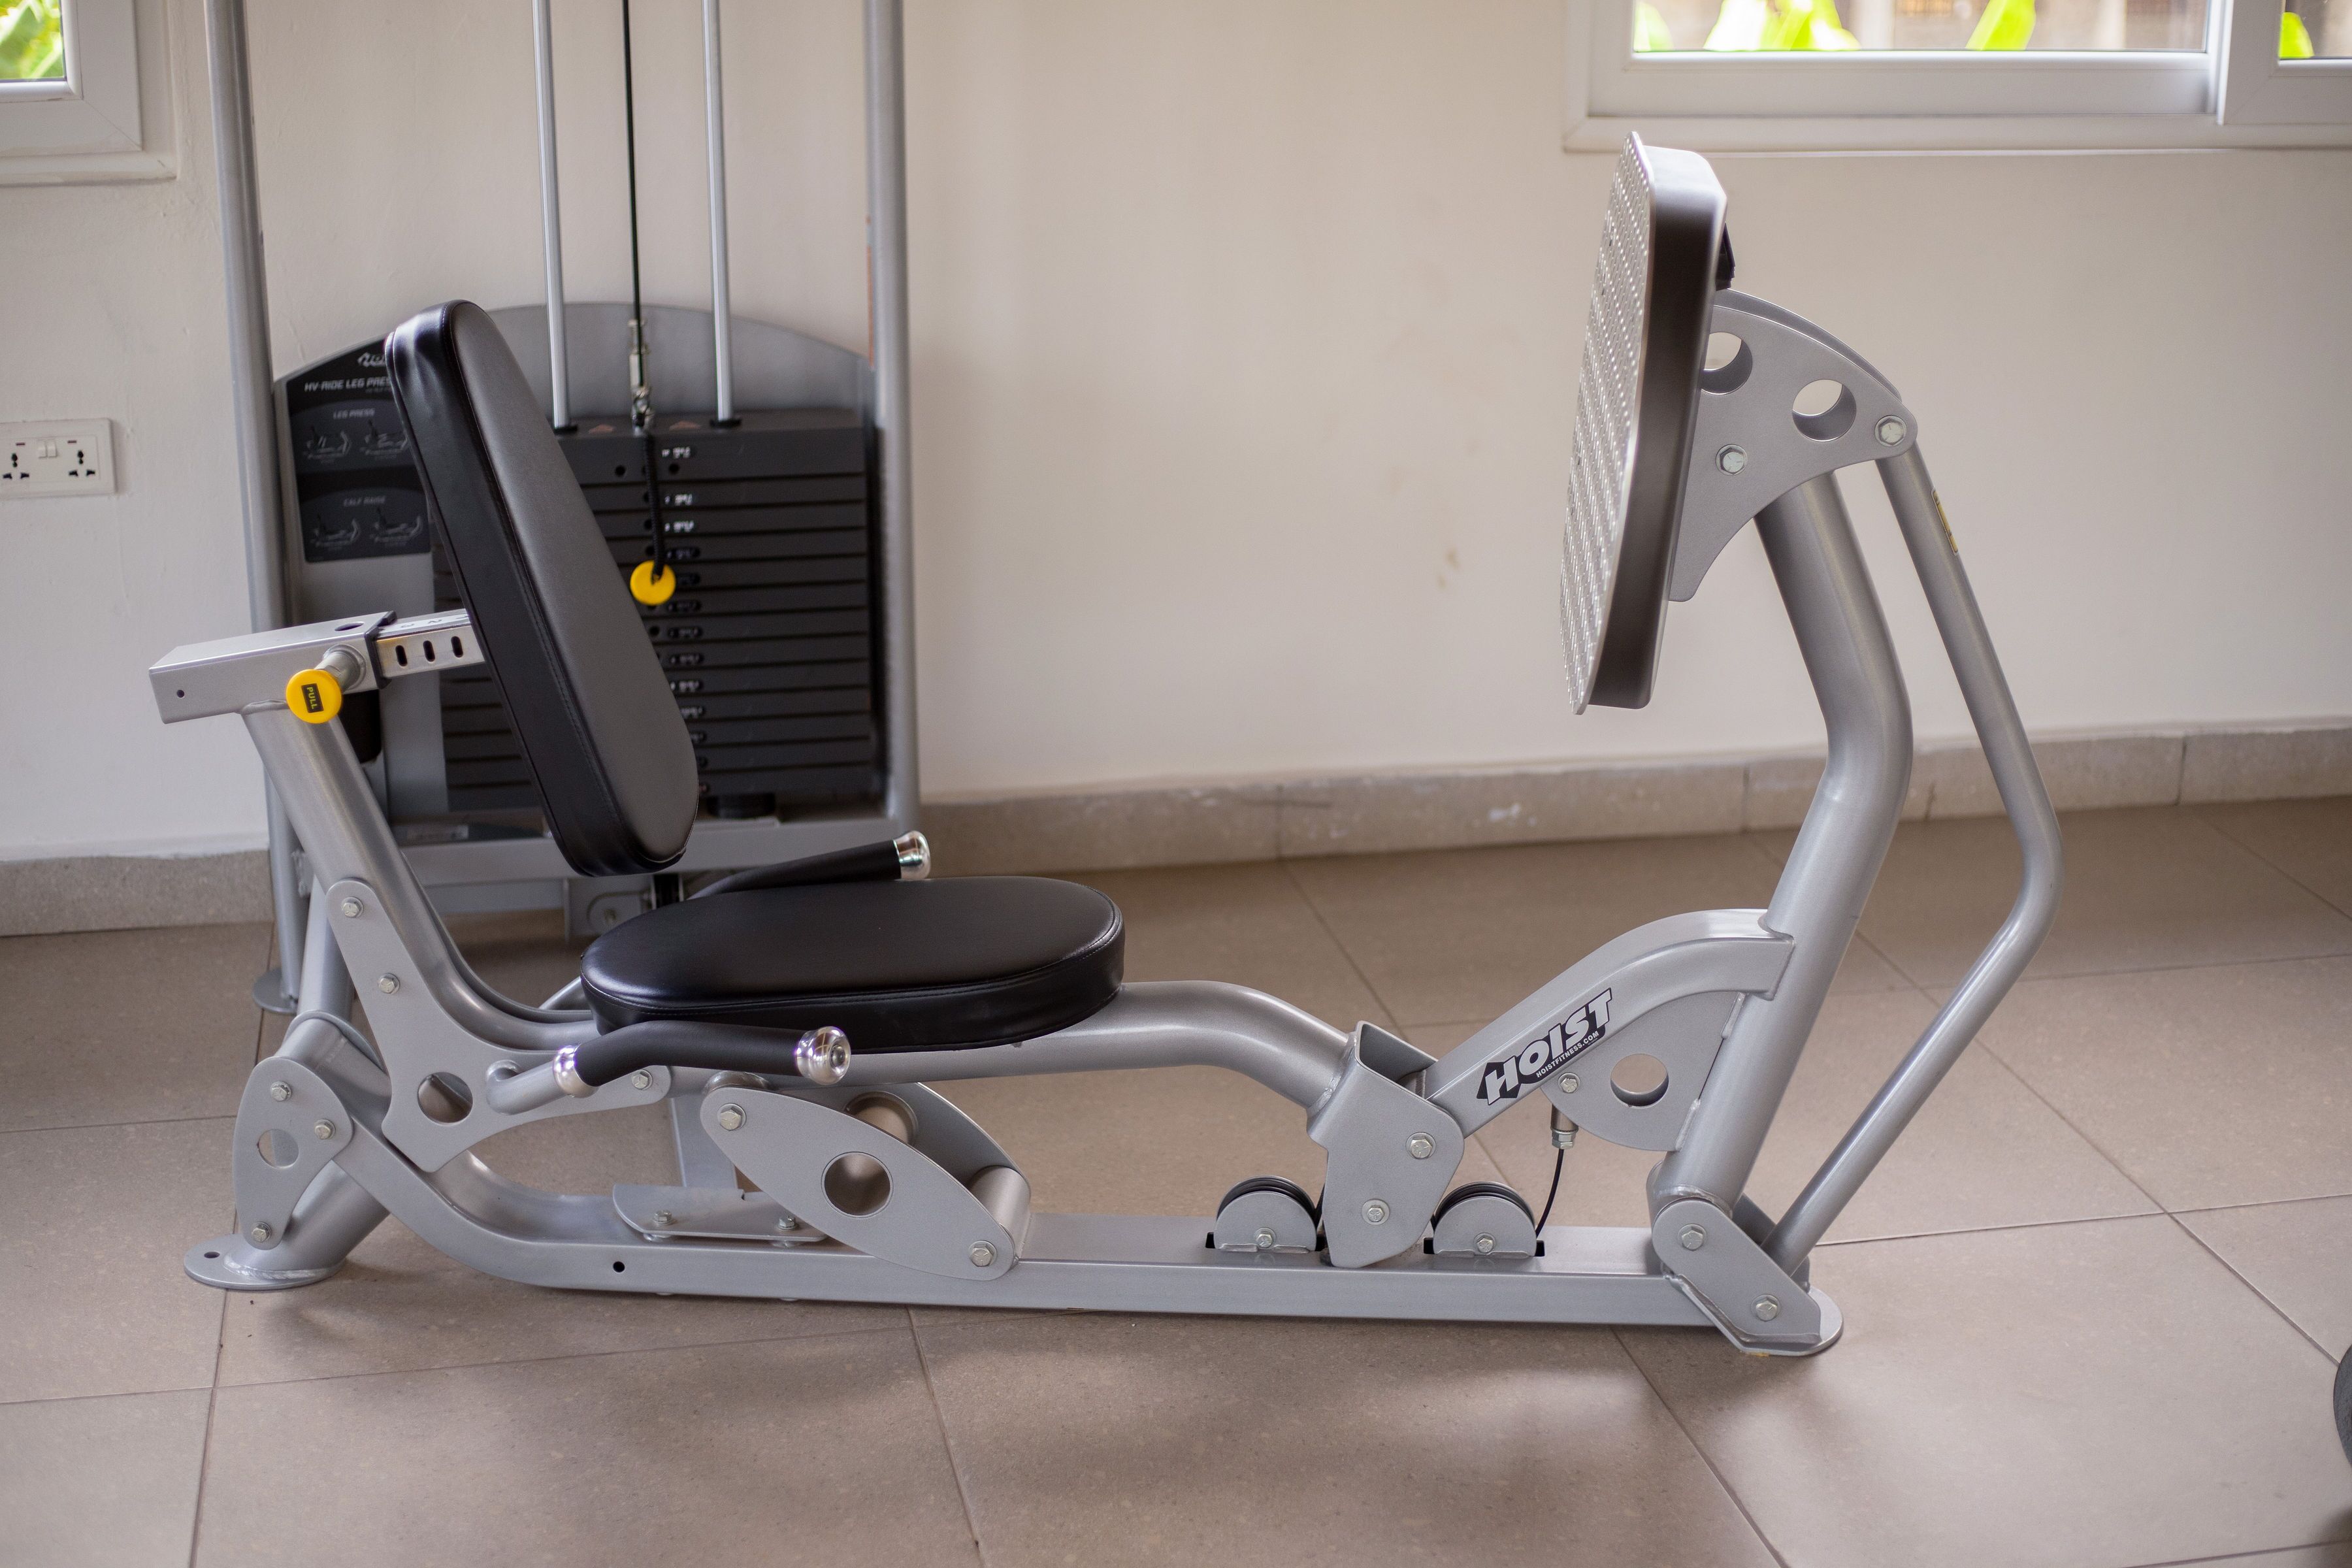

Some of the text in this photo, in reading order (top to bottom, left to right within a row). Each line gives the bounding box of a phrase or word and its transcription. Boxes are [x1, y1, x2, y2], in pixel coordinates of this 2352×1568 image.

[346, 377, 365, 389] LEG
[333, 408, 375, 419] LEG PRESS
[306, 687, 318, 710] PULL
[1484, 988, 1612, 1105] HOIST
[1536, 1030, 1599, 1078] HOISTFITNESS.COM
